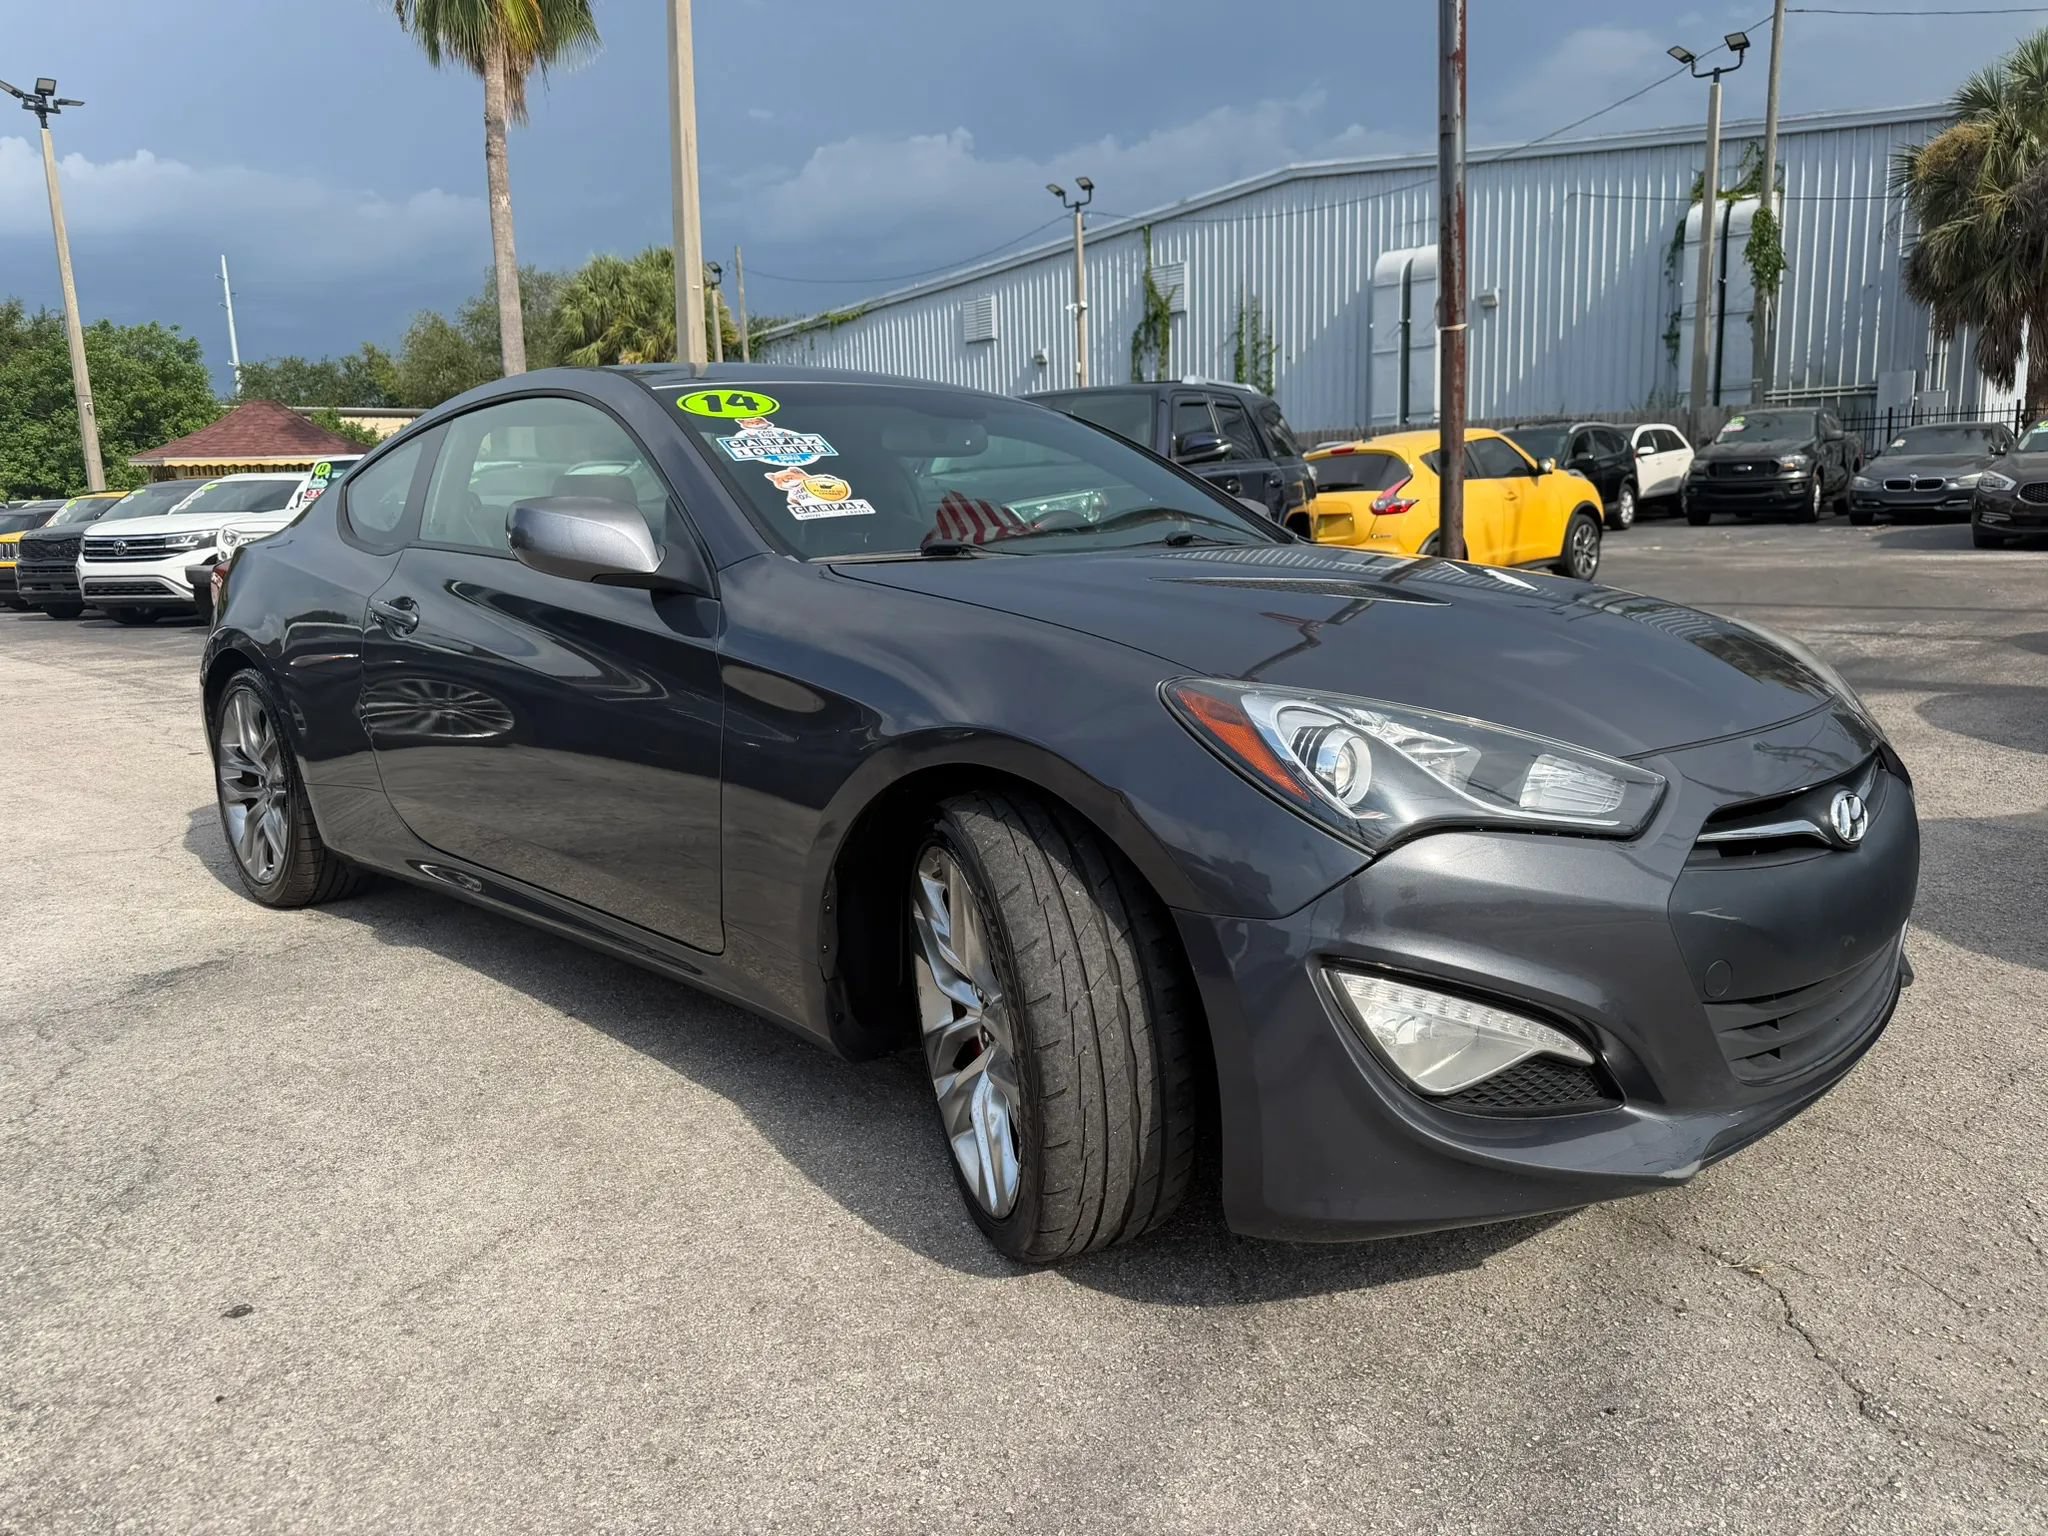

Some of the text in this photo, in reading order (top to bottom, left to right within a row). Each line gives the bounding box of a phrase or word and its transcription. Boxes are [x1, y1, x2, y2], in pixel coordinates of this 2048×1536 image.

[701, 393, 759, 413] 14
[727, 437, 818, 449] CARFAX
[751, 445, 830, 456] OWNER
[793, 502, 867, 514] CARFAX
